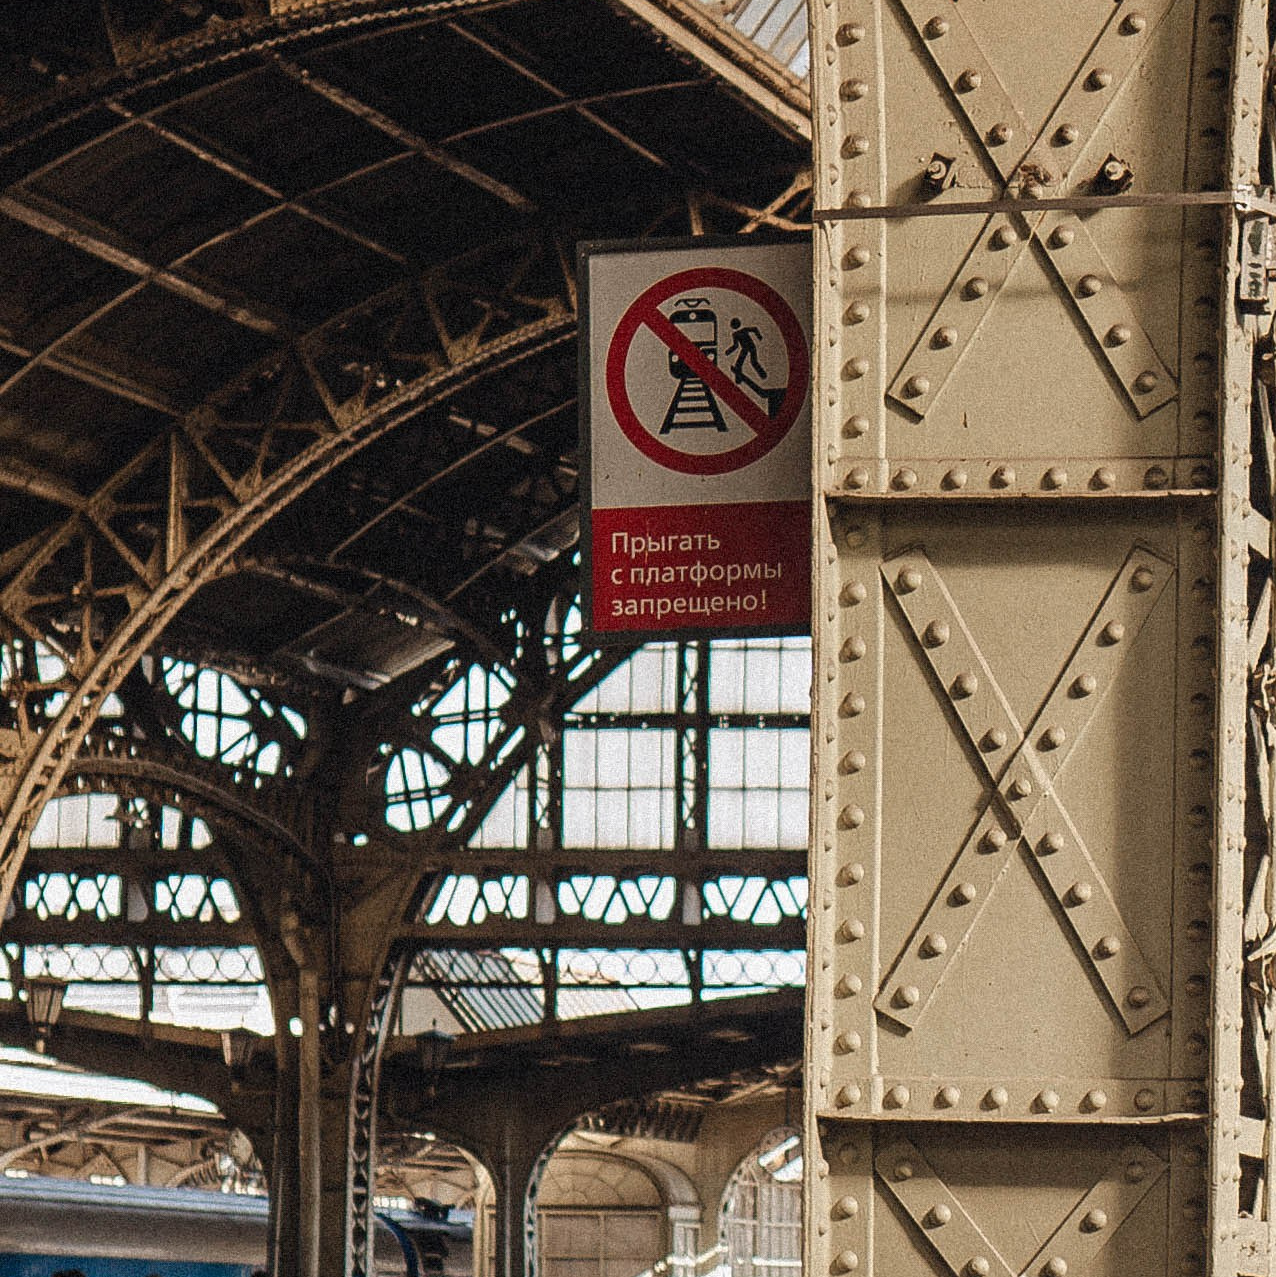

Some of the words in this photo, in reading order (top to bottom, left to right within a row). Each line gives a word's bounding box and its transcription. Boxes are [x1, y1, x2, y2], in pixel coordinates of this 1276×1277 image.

[612, 532, 721, 559] Прыгать
[611, 568, 623, 585] с
[630, 560, 782, 587] платформы
[611, 589, 767, 620] запрещено!
